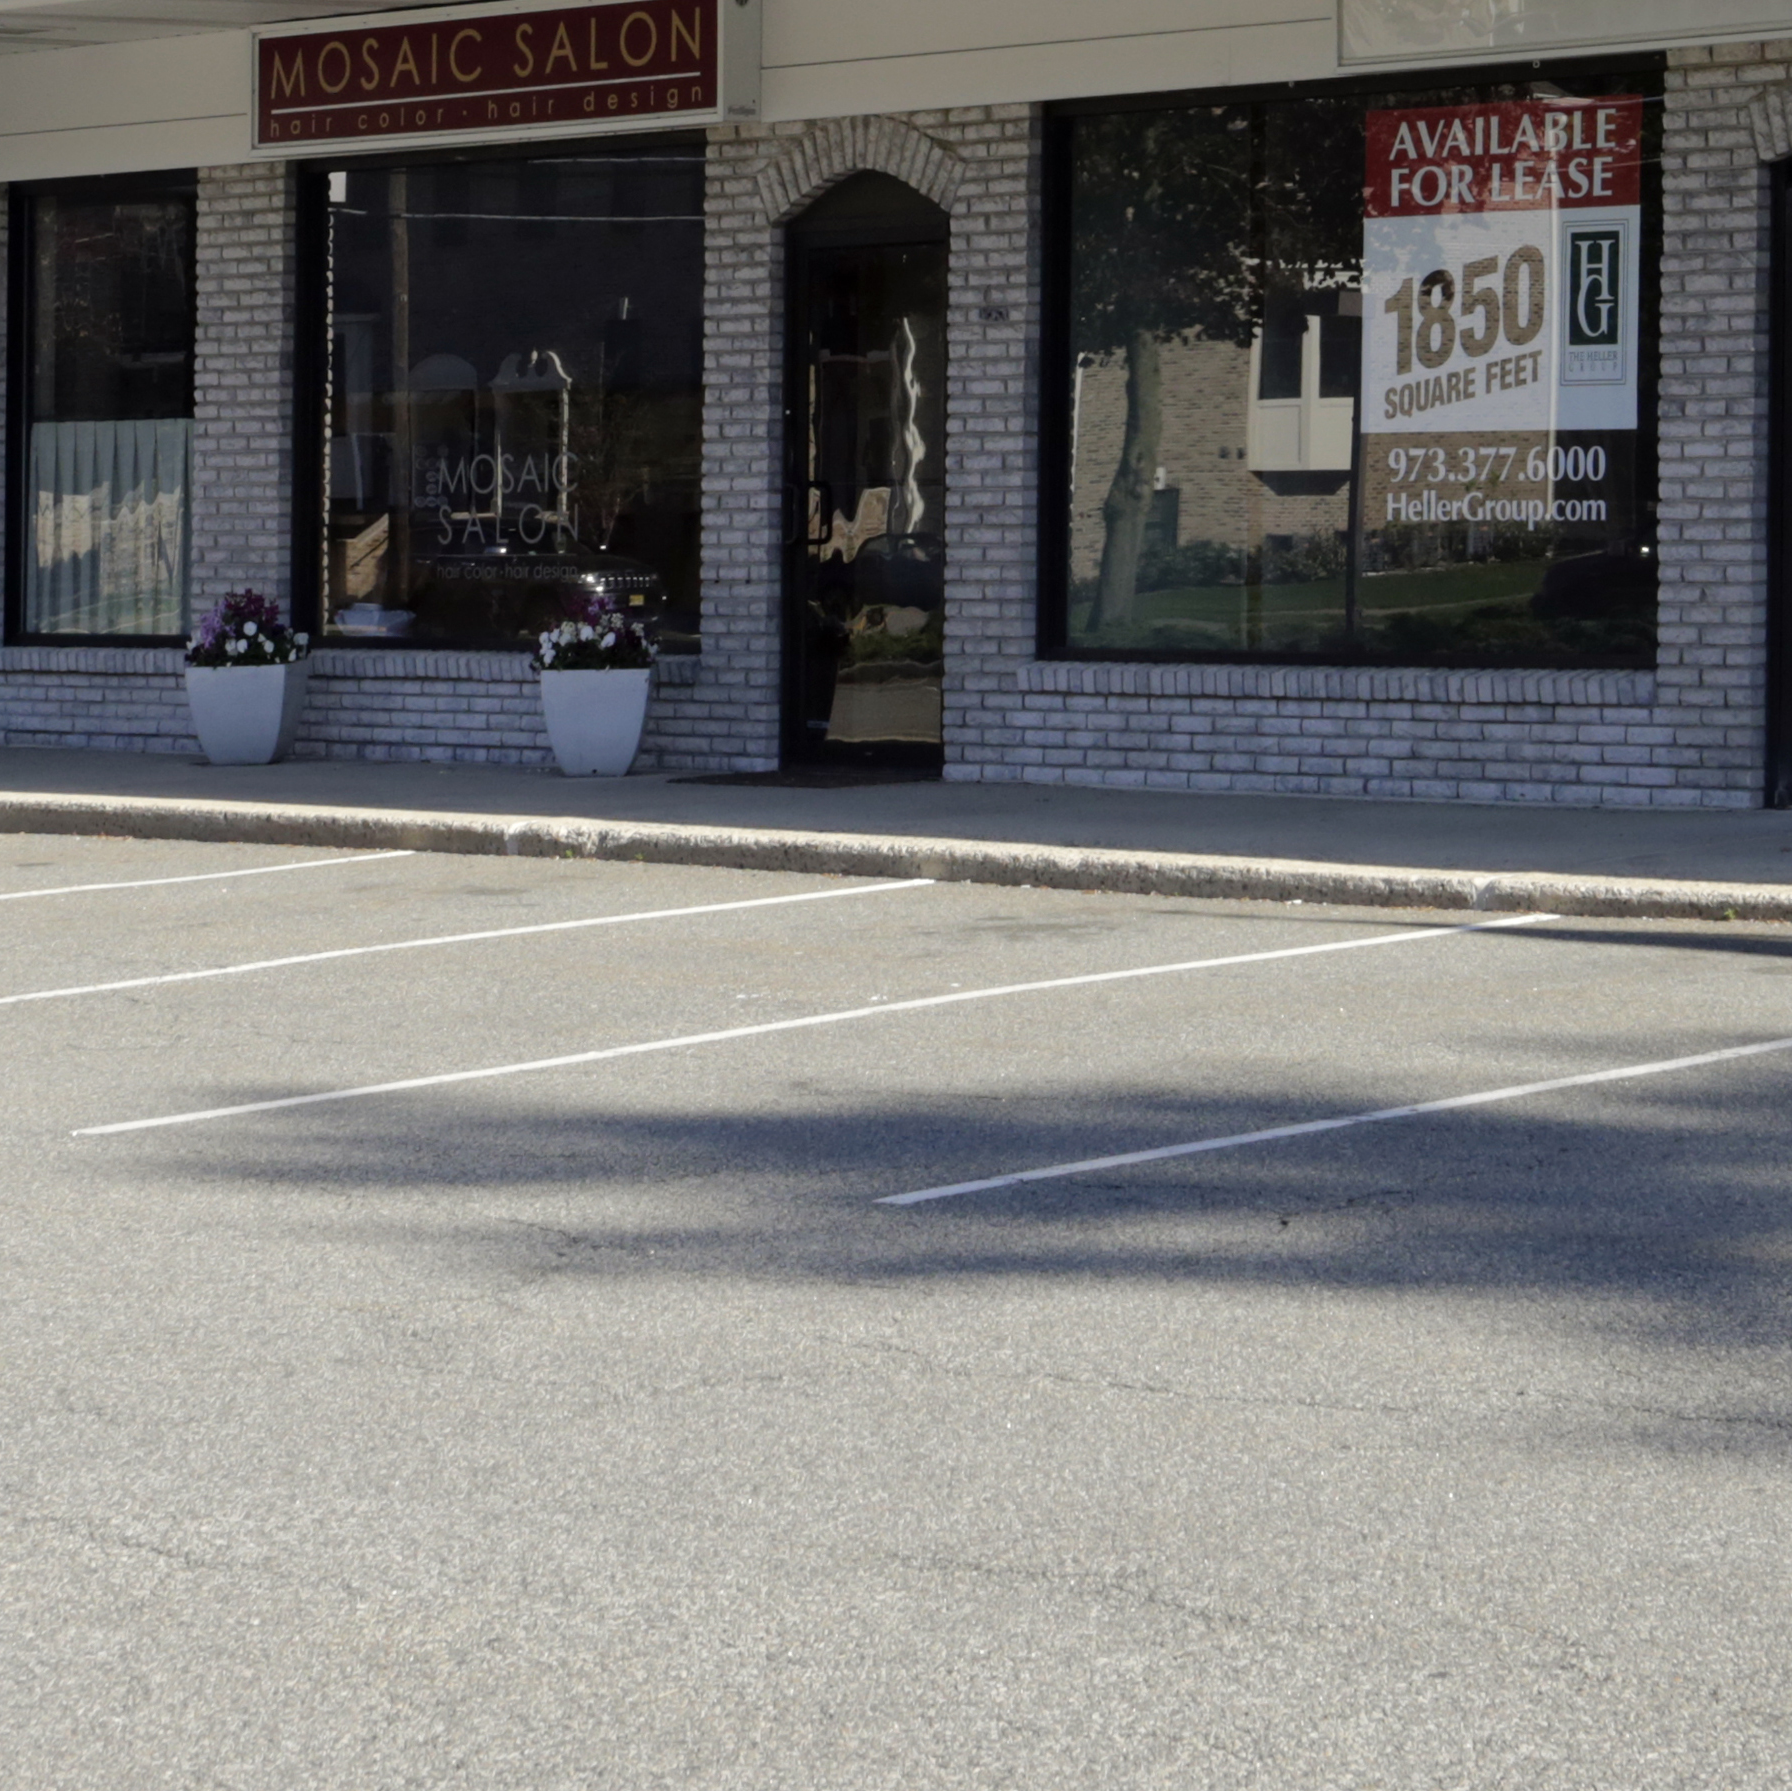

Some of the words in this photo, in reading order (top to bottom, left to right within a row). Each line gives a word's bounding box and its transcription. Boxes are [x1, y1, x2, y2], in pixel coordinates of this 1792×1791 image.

[270, 28, 482, 99] MOSAIC
[513, 7, 701, 78] SALON
[270, 116, 332, 138] hair
[357, 107, 443, 130] color
[488, 99, 554, 119] hair
[583, 85, 703, 112] design
[1389, 108, 1617, 161] AVAILABLE
[1390, 165, 1475, 207] FOR
[1491, 157, 1614, 202] LEASE
[1384, 244, 1546, 376] 1850
[1569, 351, 1584, 362] THE
[1587, 350, 1618, 361] HELLER
[1384, 367, 1476, 420] SQUARE
[1485, 350, 1543, 394] FEET
[438, 452, 578, 494] MOSAIC
[1388, 446, 1607, 483] 973.377.6000
[437, 503, 579, 545] SALON
[1386, 490, 1607, 530] HellerGroup.com
[437, 564, 460, 579] hair
[464, 564, 497, 579] color
[505, 563, 529, 579] hair
[533, 563, 578, 581] design
